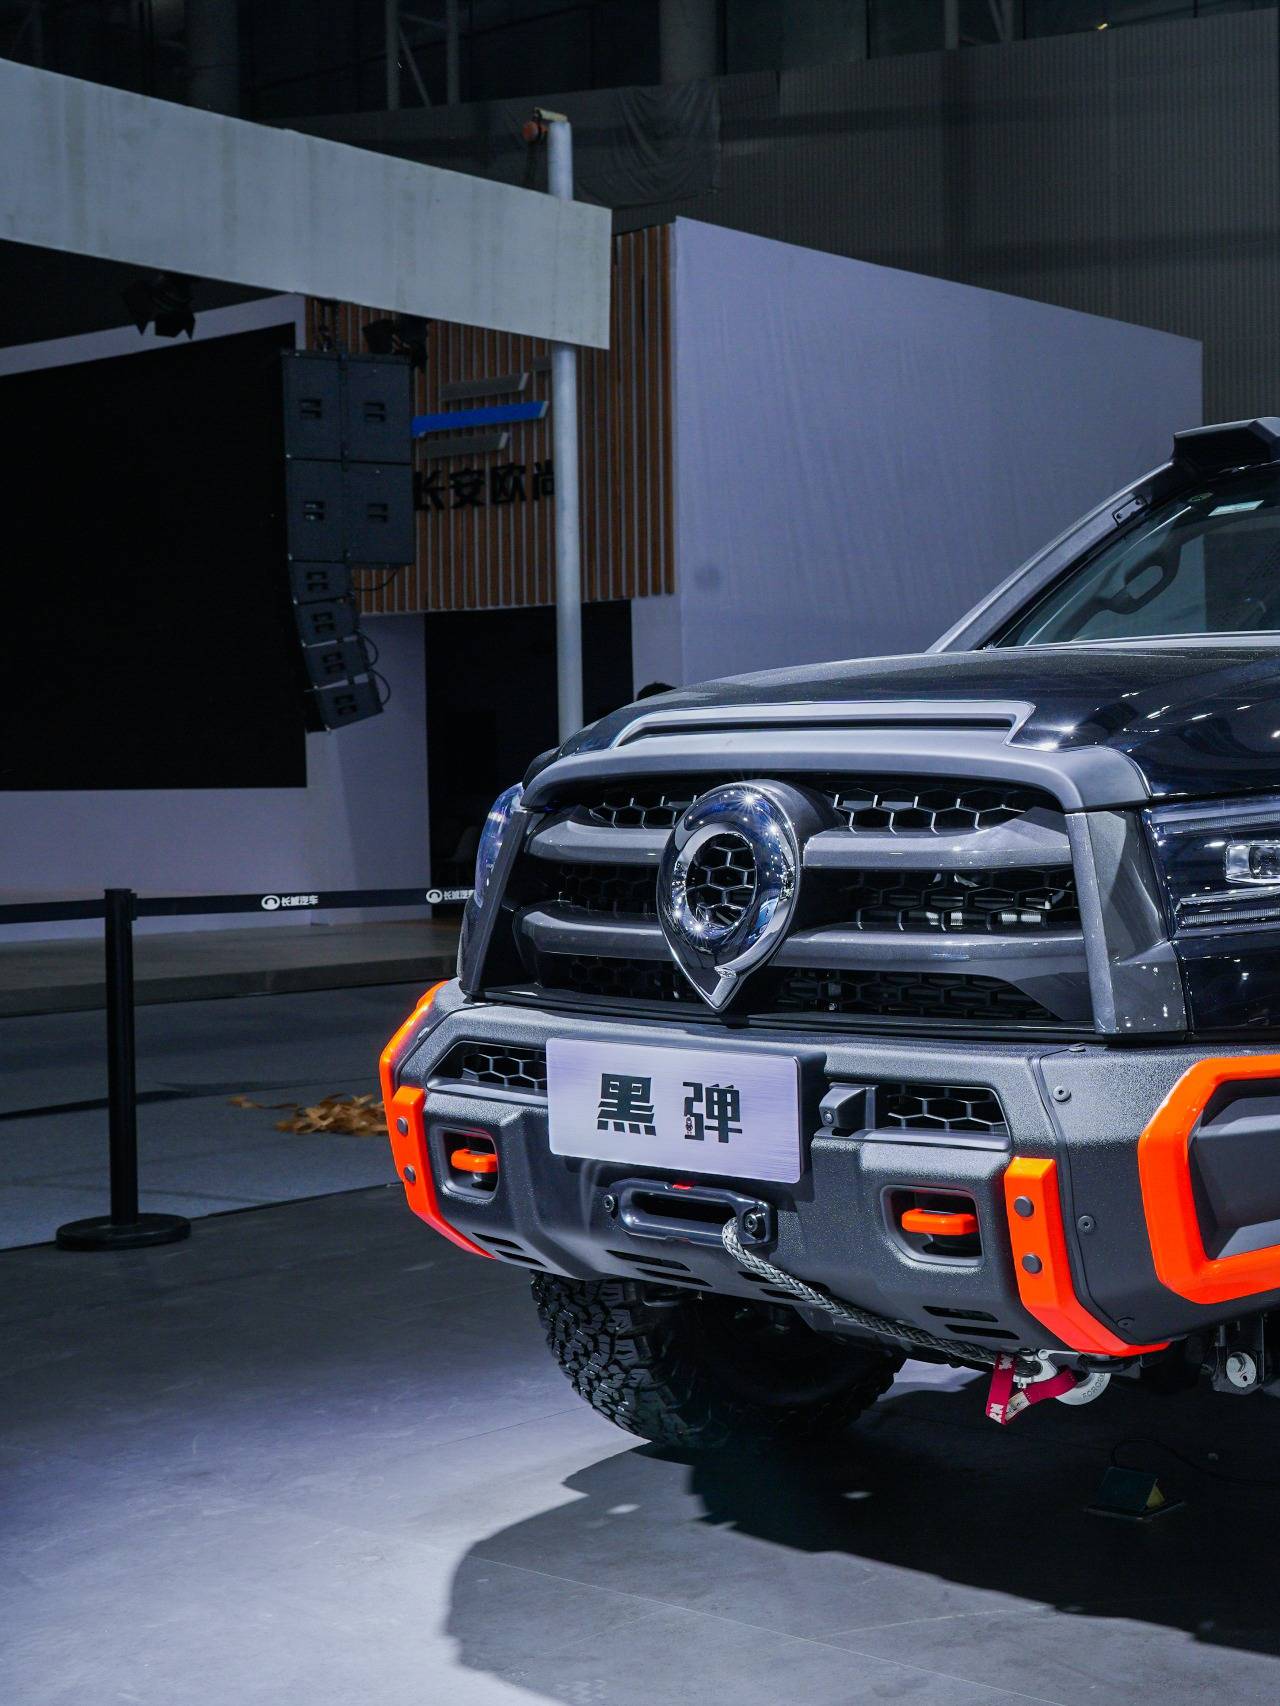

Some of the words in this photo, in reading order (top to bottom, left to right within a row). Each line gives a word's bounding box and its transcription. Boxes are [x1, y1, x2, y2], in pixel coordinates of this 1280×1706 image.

[281, 895, 318, 906] 长城汽车
[597, 1073, 743, 1143] 黑弹
